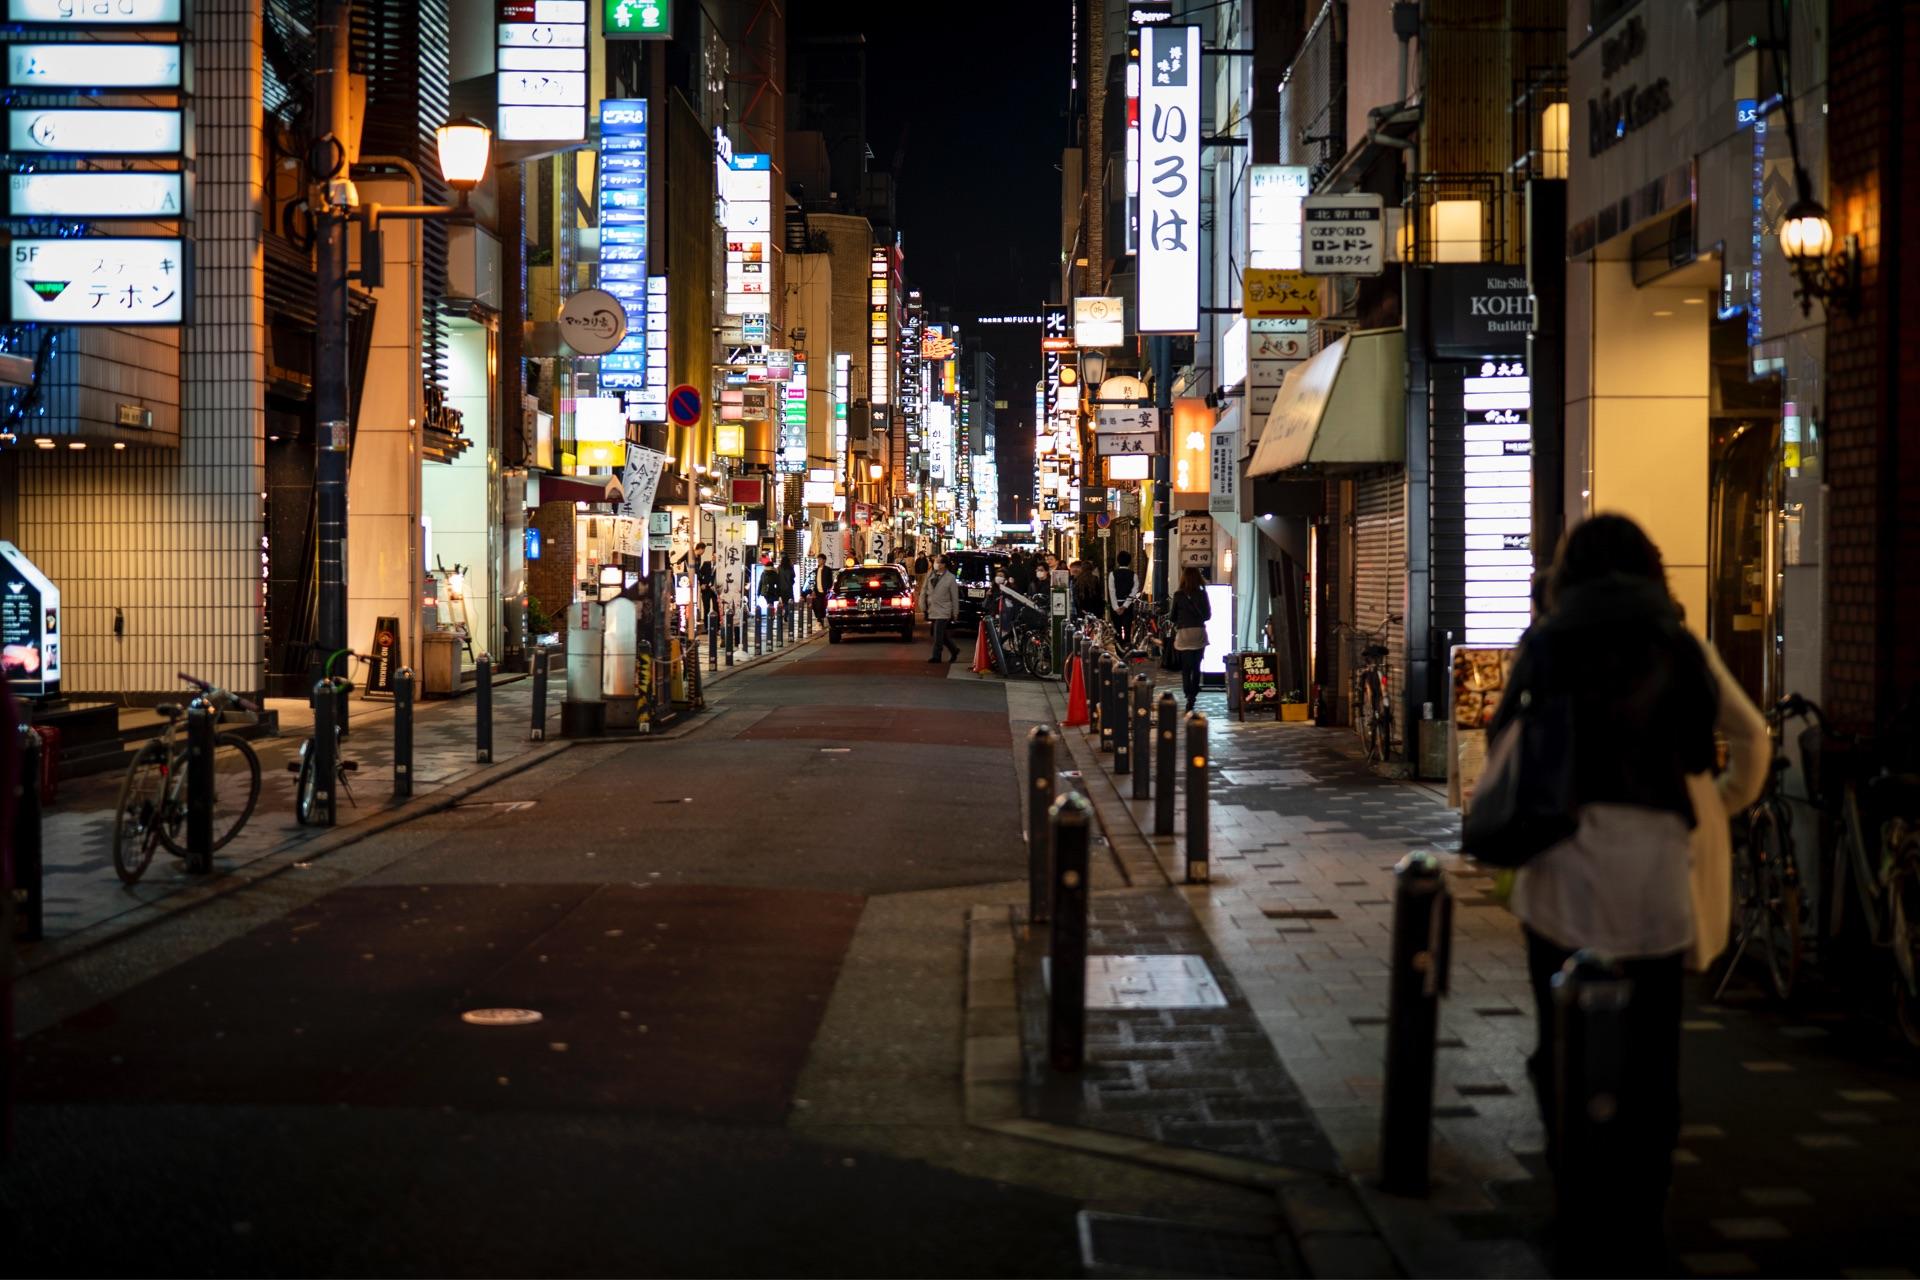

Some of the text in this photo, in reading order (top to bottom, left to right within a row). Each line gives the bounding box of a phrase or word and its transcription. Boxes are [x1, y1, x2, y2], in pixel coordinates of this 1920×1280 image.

[1151, 103, 1188, 252] いろは
[1315, 211, 1370, 219] 北新地
[1311, 227, 1365, 236] OXFORD
[1312, 240, 1372, 251] ロンドン
[16, 246, 39, 262] 5F
[1315, 256, 1371, 265] 高級ネクタイ
